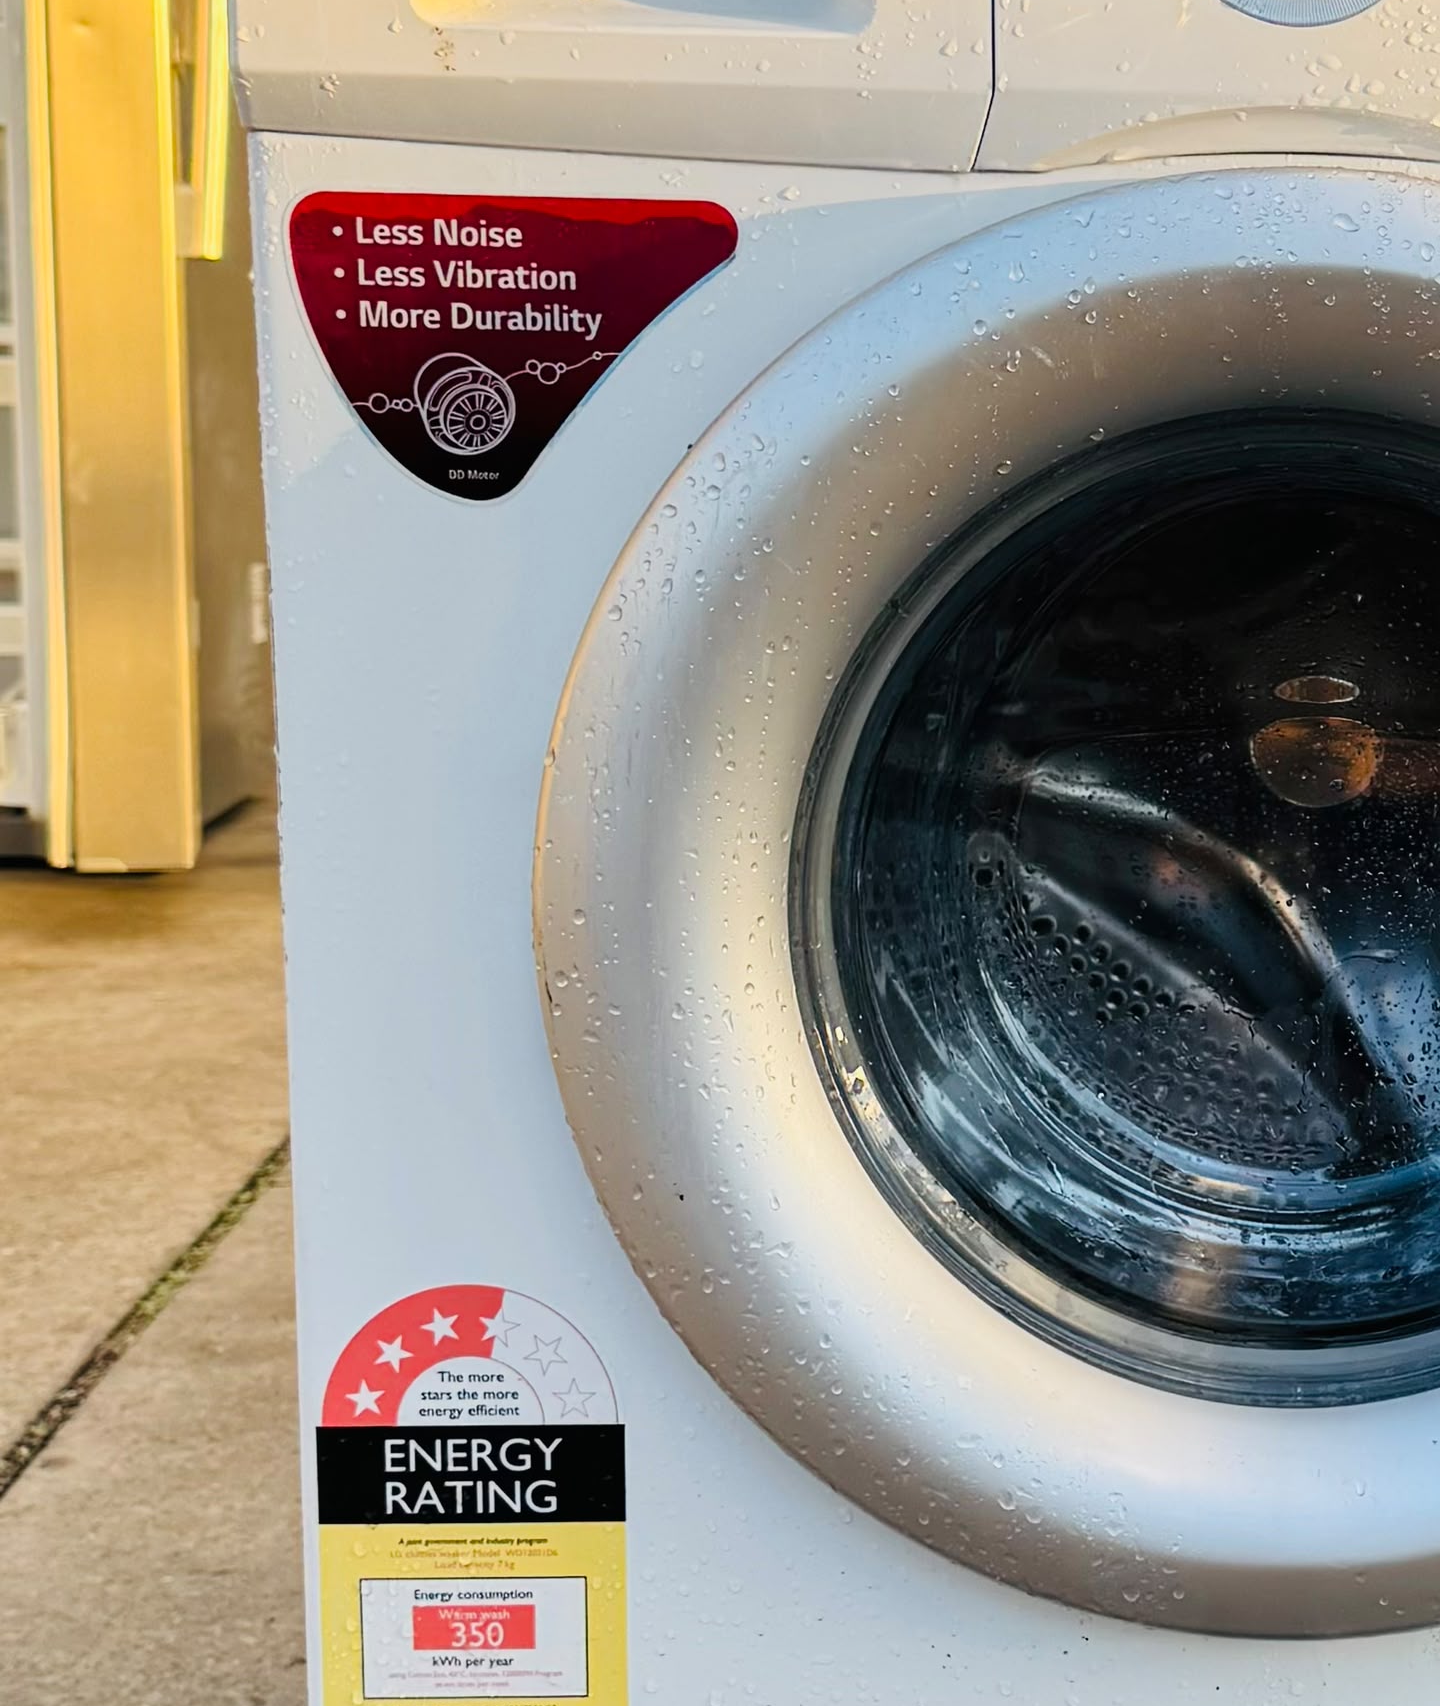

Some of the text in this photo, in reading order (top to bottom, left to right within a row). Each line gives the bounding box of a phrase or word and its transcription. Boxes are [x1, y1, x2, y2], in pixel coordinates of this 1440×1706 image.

[355, 217, 523, 248] Less Noise
[357, 258, 577, 291] Less Vibration
[358, 300, 602, 340] More Durability
[448, 469, 500, 480] DD Motor
[437, 1371, 504, 1383] The more
[420, 1389, 519, 1401] stars the more
[419, 1405, 520, 1420] energy efficient
[384, 1437, 563, 1472] ENERGY
[385, 1479, 558, 1515] RATING
[414, 1589, 534, 1602] Energy consumption
[438, 1609, 510, 1620] Warm wash
[450, 1622, 504, 1647] 350
[432, 1656, 514, 1669] kWh per year
